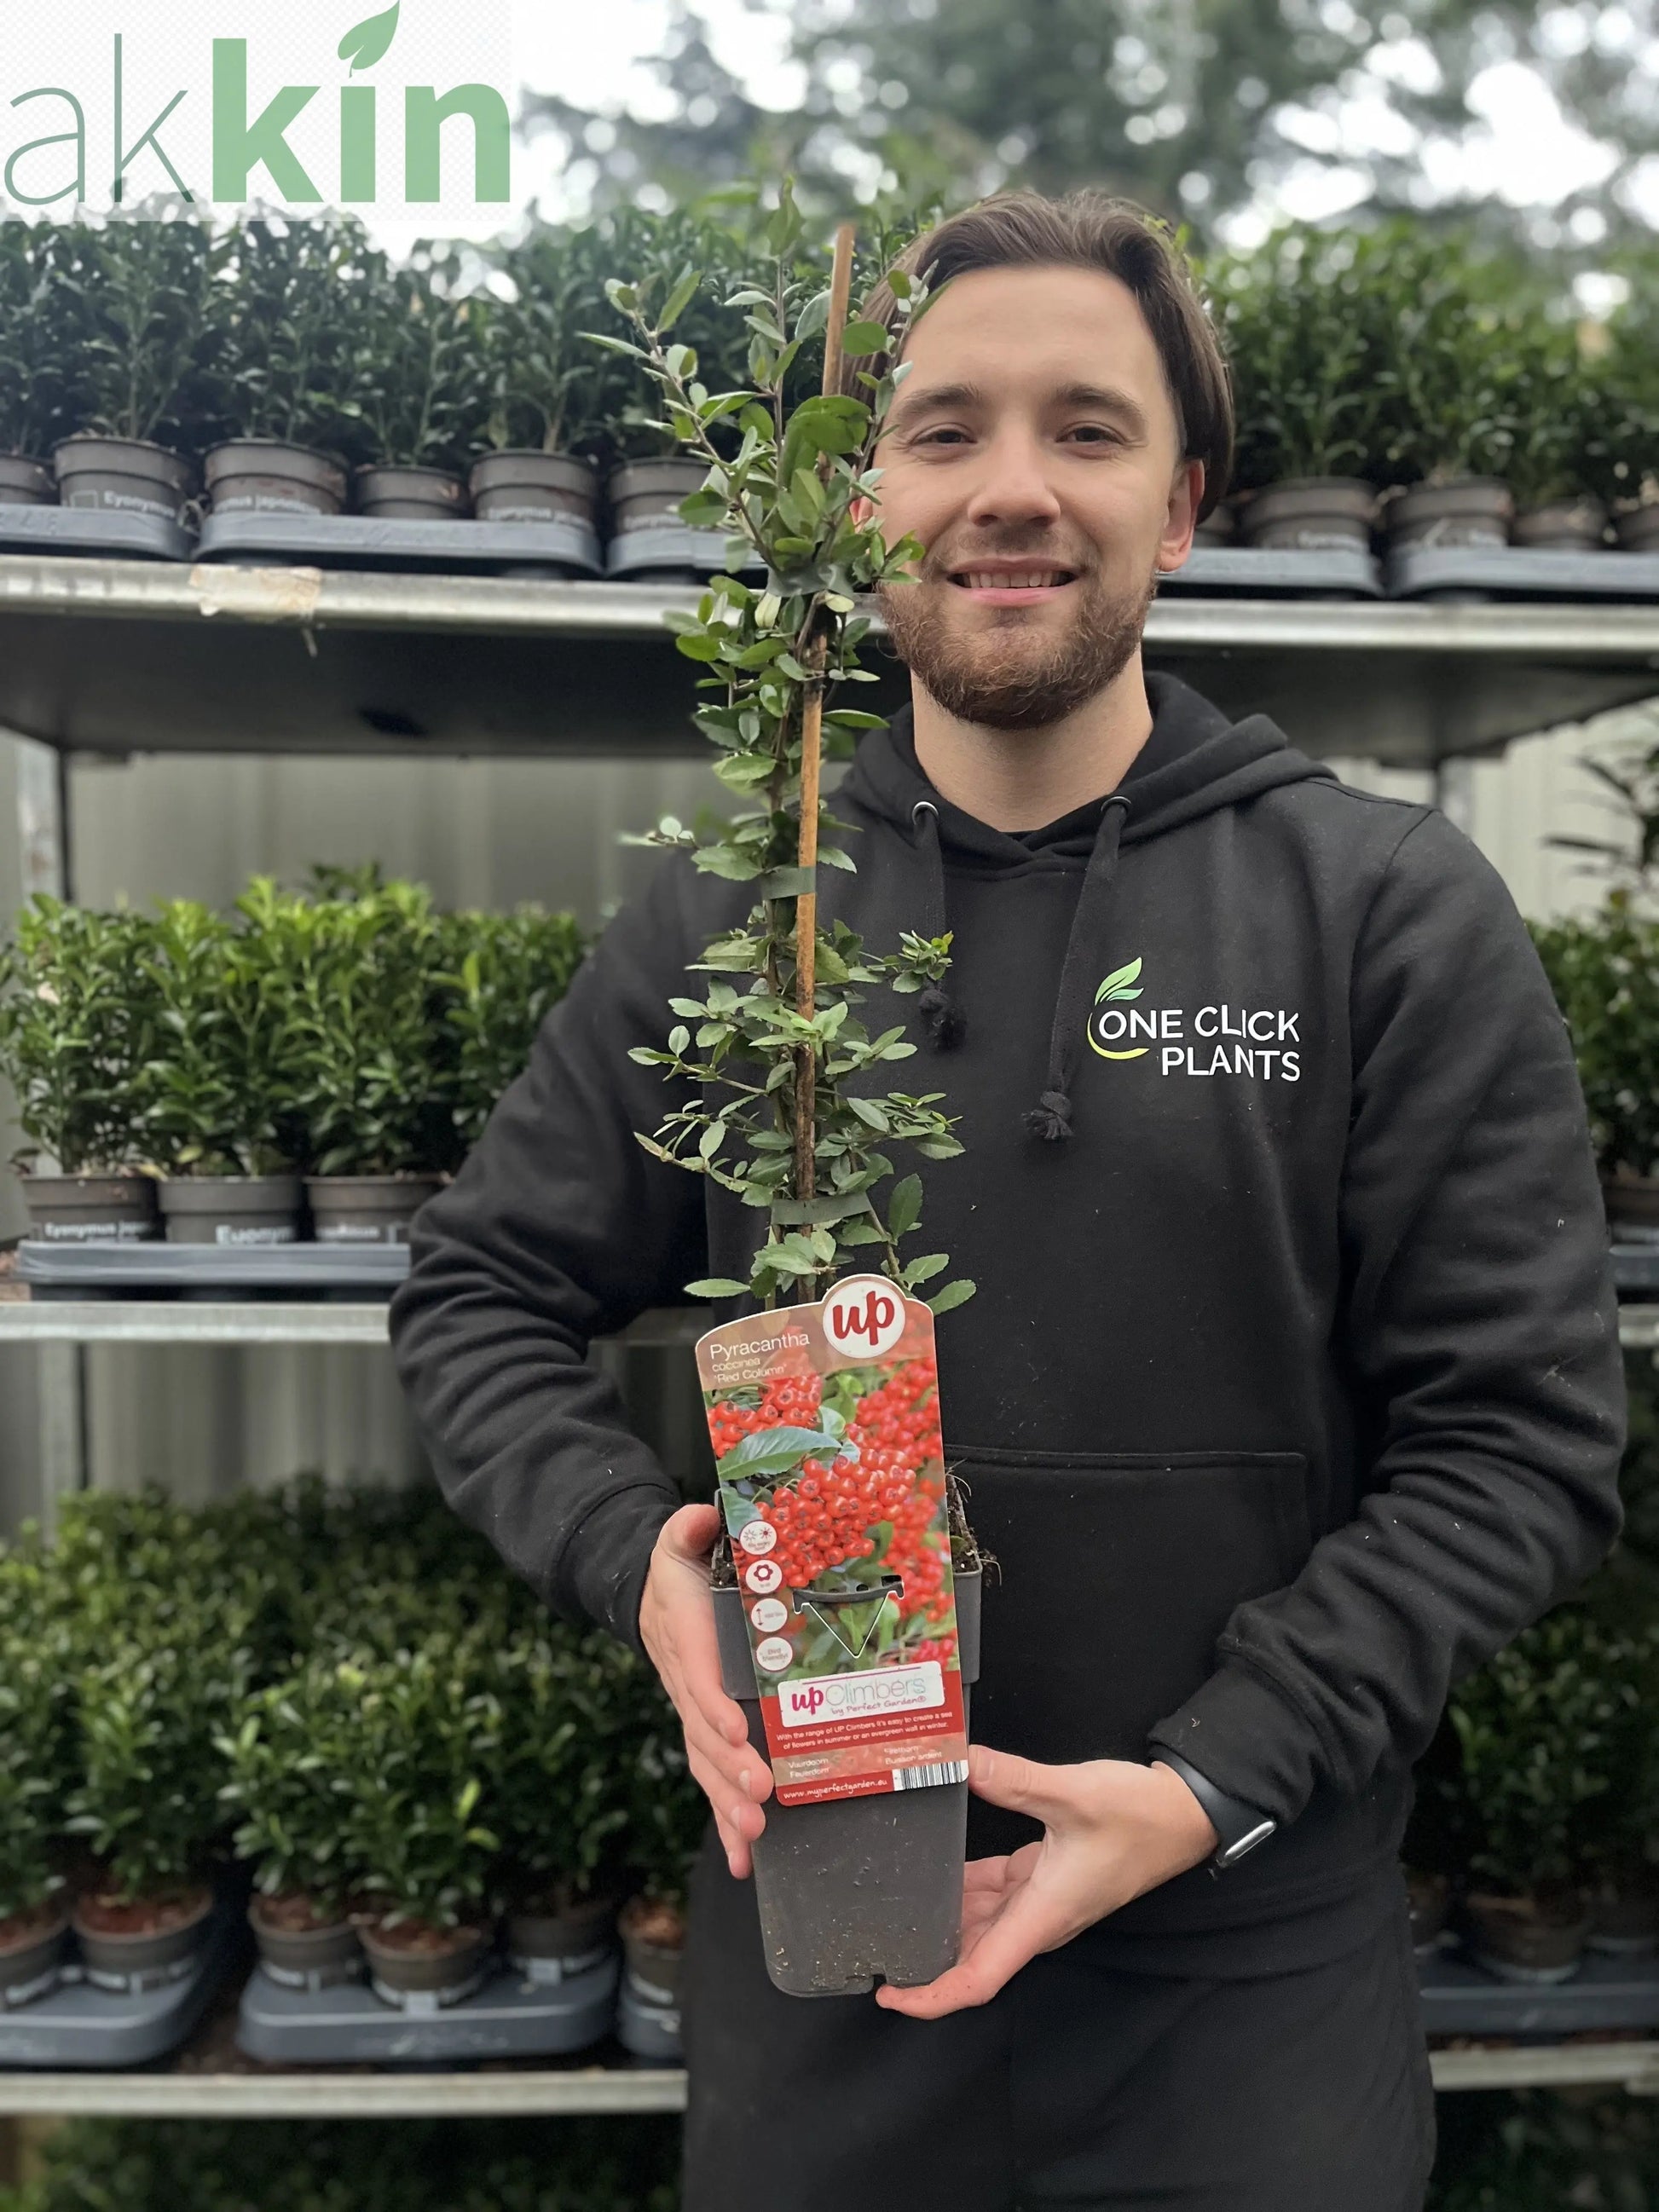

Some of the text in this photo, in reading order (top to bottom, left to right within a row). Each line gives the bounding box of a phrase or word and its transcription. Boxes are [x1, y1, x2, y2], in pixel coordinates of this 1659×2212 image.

[1098, 1004, 1301, 1042] ONE CLICK
[1161, 1043, 1302, 1083] PLANTS
[832, 1290, 895, 1346] up
[709, 1332, 811, 1362] Pyracantha
[711, 1357, 761, 1372] coccinea
[831, 1707, 844, 1716] by
[846, 1702, 882, 1712] Perfect
[776, 1733, 793, 1741] With
[805, 1730, 825, 1738] range
[846, 1720, 876, 1731] Climbers
[887, 1718, 904, 1726] easy
[912, 1713, 934, 1723] create
[791, 1740, 816, 1749] flowers
[824, 1736, 852, 1745] summer
[870, 1728, 905, 1738] evergreen
[905, 1724, 919, 1733] wall
